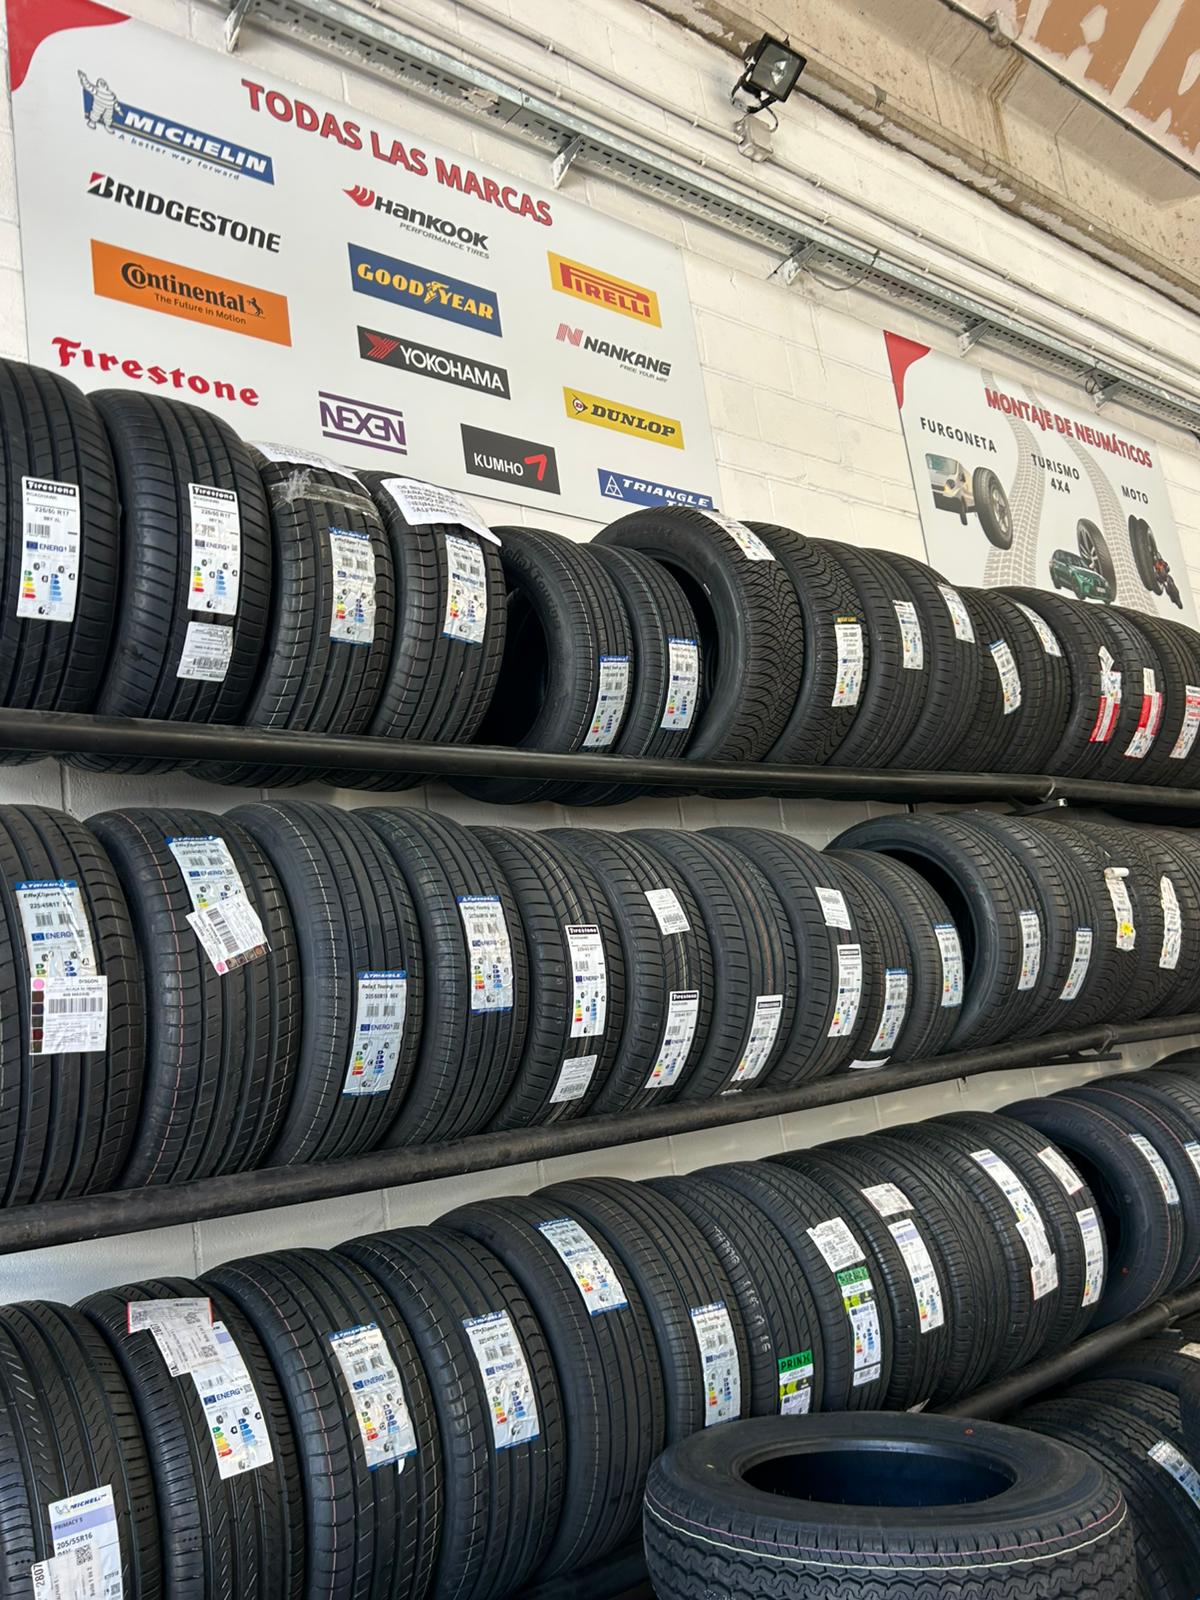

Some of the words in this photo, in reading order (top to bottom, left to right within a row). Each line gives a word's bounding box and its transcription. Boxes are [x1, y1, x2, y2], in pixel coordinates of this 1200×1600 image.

[124, 109, 267, 174] MICHELIN
[131, 137, 166, 155] better
[172, 152, 191, 166] way
[198, 160, 240, 181] forward
[241, 78, 362, 151] TODAS
[371, 131, 428, 177] LAS
[435, 157, 553, 226] MARCAS
[87, 171, 281, 254] BRIDGESTONE
[400, 222, 465, 252] PERFORMANCE
[468, 246, 490, 259] TIRES
[121, 262, 246, 313] Continental
[560, 262, 651, 318] PIRELLI
[154, 293, 172, 305] The
[174, 297, 203, 315] Future
[216, 307, 246, 325] Motion
[52, 337, 259, 405] Firestone
[400, 344, 505, 393] YOKOHAMA
[584, 336, 672, 377] NANKANG
[592, 402, 677, 438] DUNLOP
[920, 417, 997, 453] FURGONETA
[985, 388, 1053, 431] MONTAJE
[1056, 414, 1073, 438] DE
[1074, 422, 1153, 468] NEUMÁTICOS
[473, 450, 524, 478] KUMHO
[1031, 454, 1080, 480] TURISMO
[622, 479, 710, 507] TRIANGLE
[1121, 485, 1149, 504] MOTO
[780, 1353, 811, 1370] PRINX
[57, 1532, 93, 1550] 205/55R16
